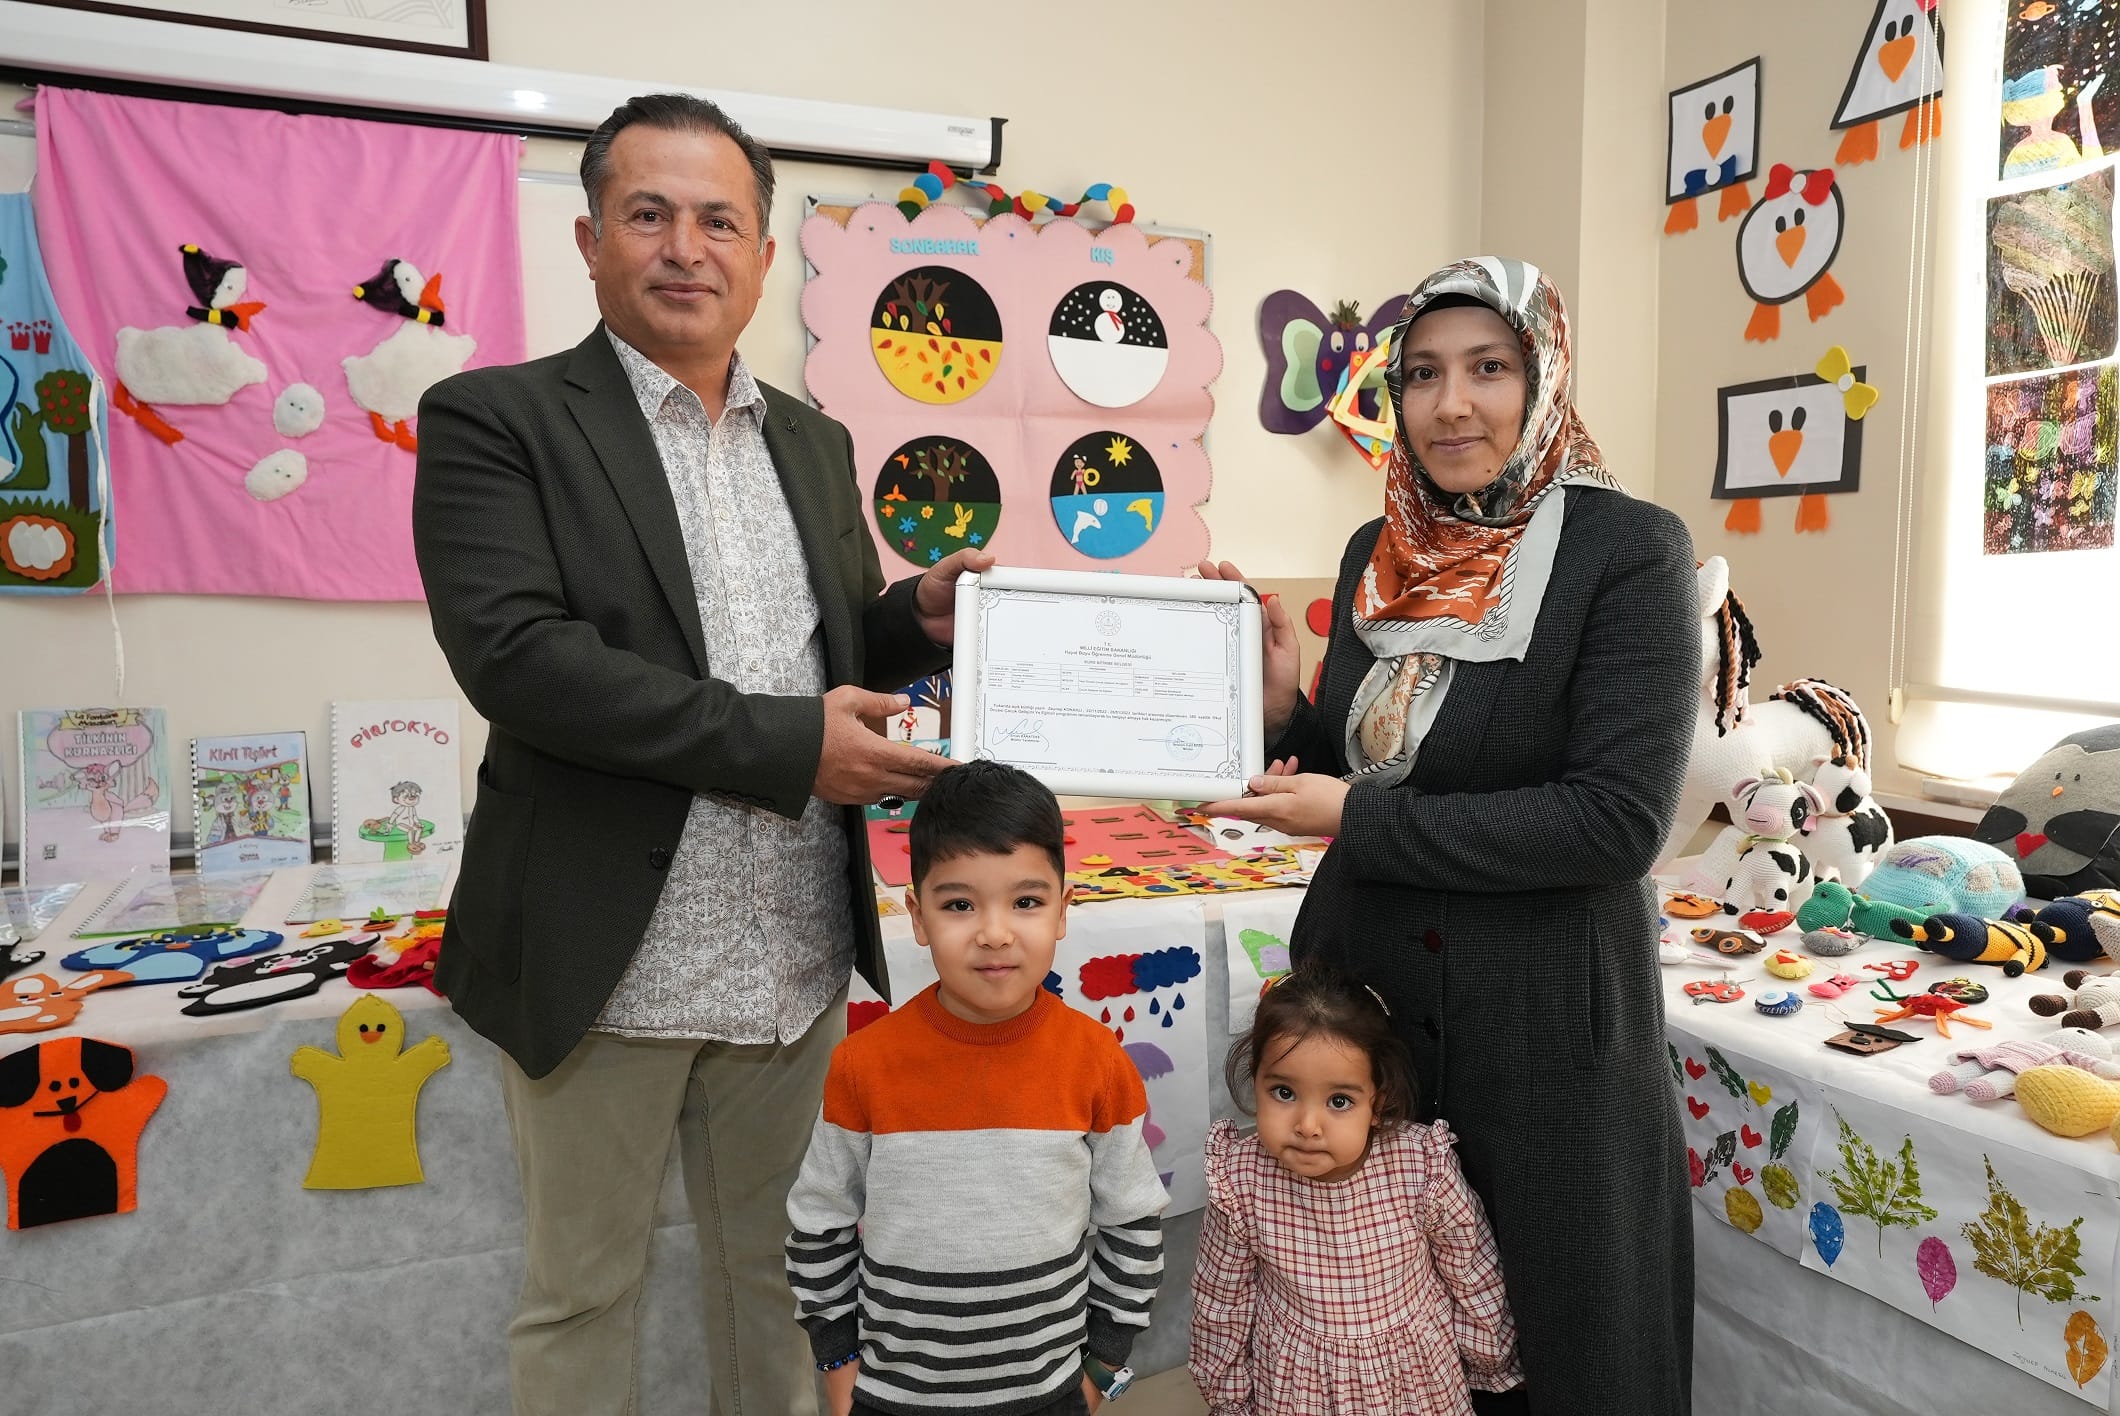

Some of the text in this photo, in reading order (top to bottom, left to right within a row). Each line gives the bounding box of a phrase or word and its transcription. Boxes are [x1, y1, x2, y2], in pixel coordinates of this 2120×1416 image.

[890, 237, 980, 256] SONBAHAR
[1090, 246, 1115, 265] KIŞ
[73, 731, 127, 745] TİLKİNİN
[64, 742, 138, 758] KURNAZLIĞI
